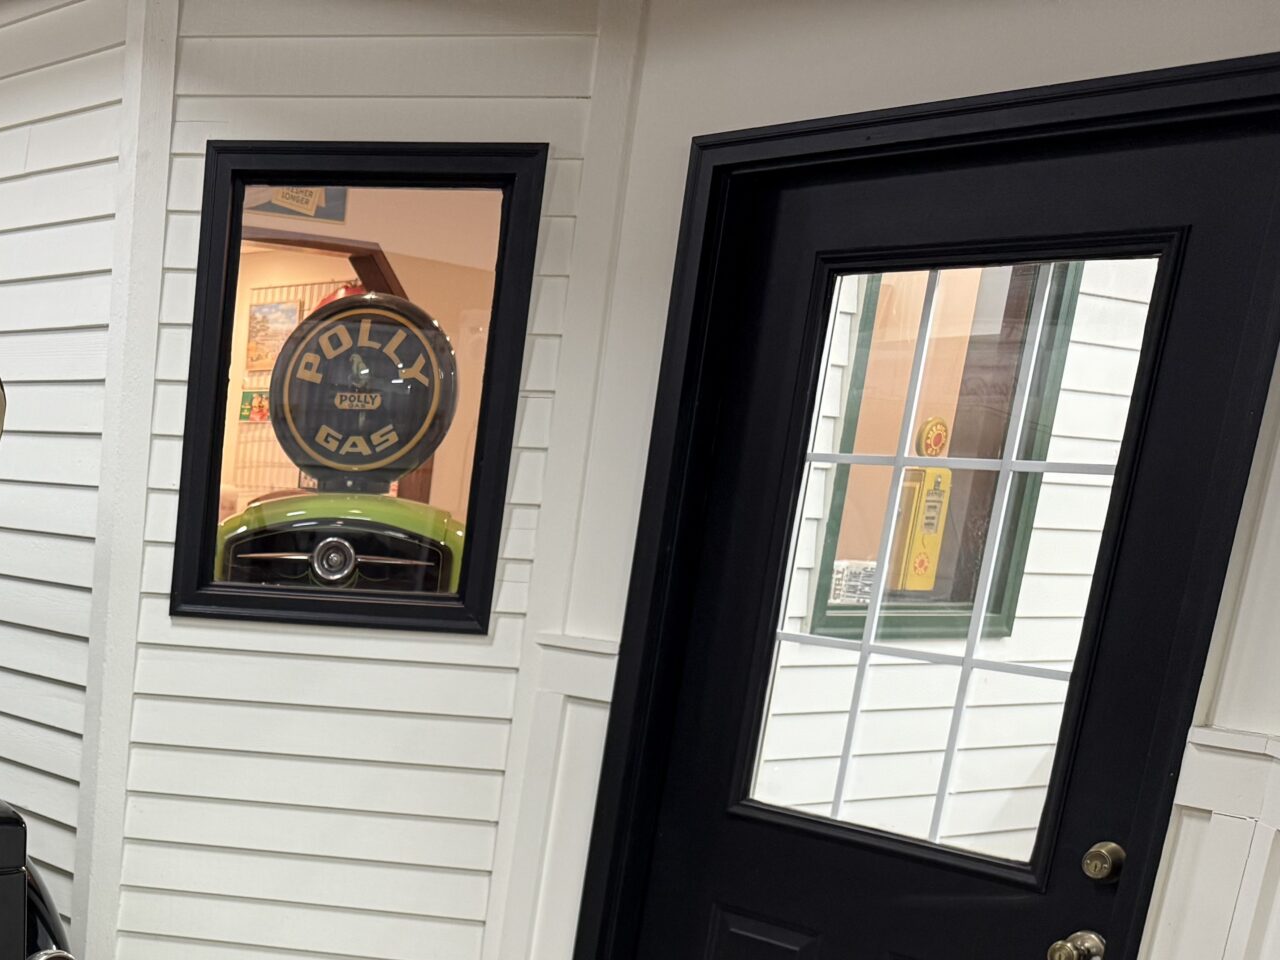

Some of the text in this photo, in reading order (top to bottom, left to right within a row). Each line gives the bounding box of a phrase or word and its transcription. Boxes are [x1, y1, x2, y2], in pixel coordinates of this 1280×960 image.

[296, 319, 430, 387] POLLY
[339, 394, 378, 404] POLLY
[315, 424, 399, 456] GAS
